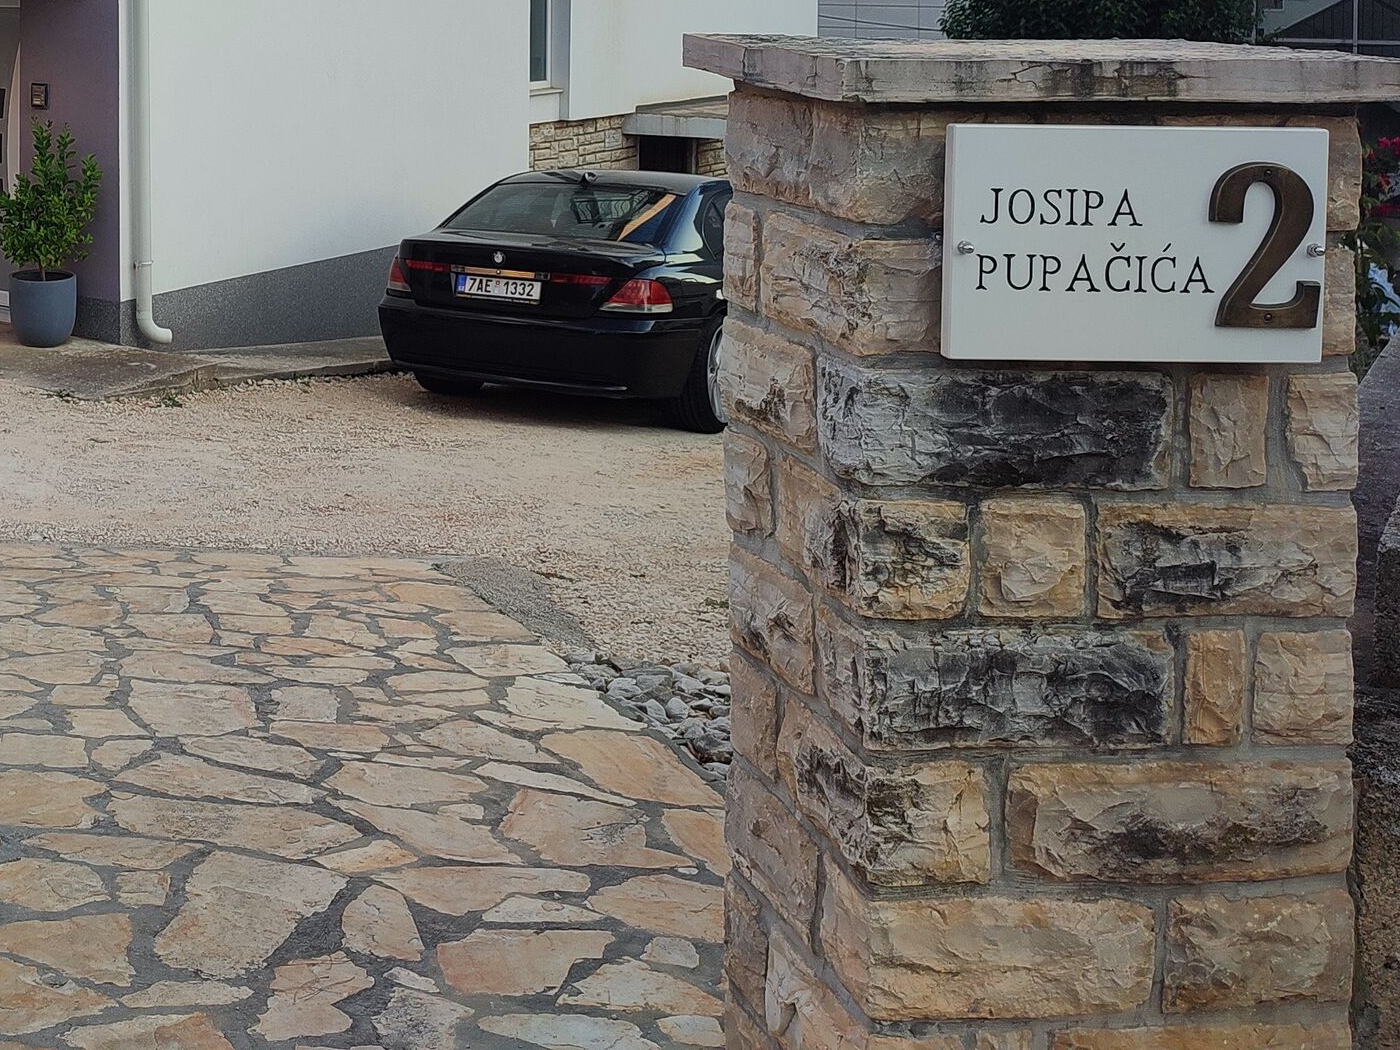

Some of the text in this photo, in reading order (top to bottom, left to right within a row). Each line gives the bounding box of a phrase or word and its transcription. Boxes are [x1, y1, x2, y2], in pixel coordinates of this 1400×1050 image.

[980, 188, 1143, 227] JOSIPA
[1208, 161, 1321, 328] 2
[468, 277, 535, 297] 7AE 1332
[975, 242, 1215, 294] PUPAČIĆA
